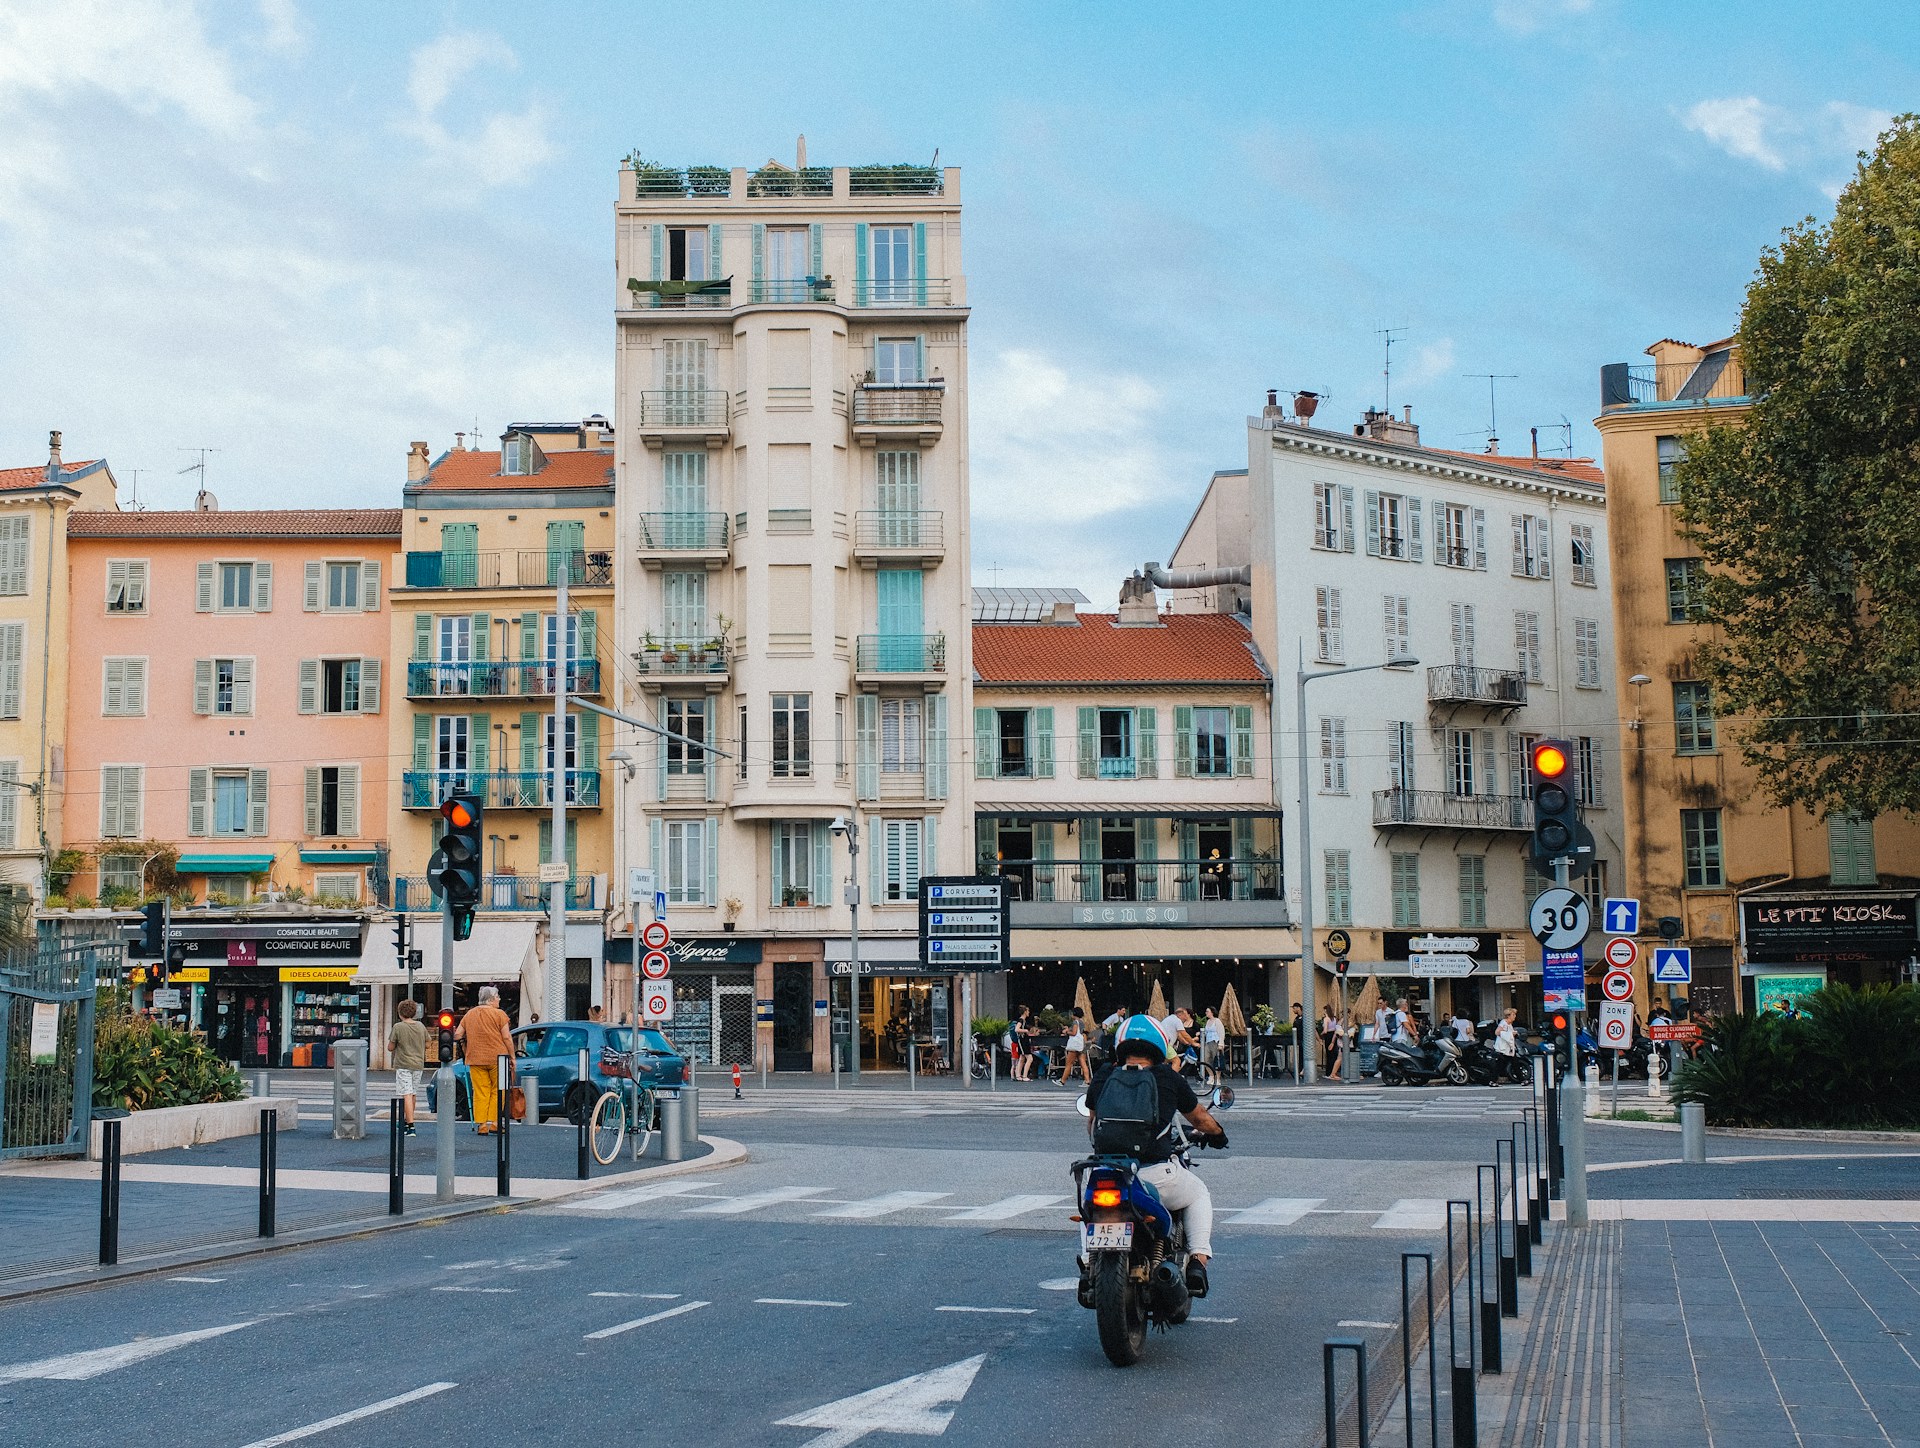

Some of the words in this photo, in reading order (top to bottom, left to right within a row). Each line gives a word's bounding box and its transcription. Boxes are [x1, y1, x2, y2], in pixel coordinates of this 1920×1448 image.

[1082, 907, 1179, 922] senso
[1542, 907, 1577, 931] 30
[1758, 907, 1781, 923] LE
[317, 928, 339, 936] BEAUTE
[265, 941, 319, 950] COSMETIQUE
[320, 940, 351, 949] BEAUTE
[652, 1001, 663, 1009] 30
[1610, 1025, 1622, 1035] 30
[1100, 1224, 1113, 1234] AE
